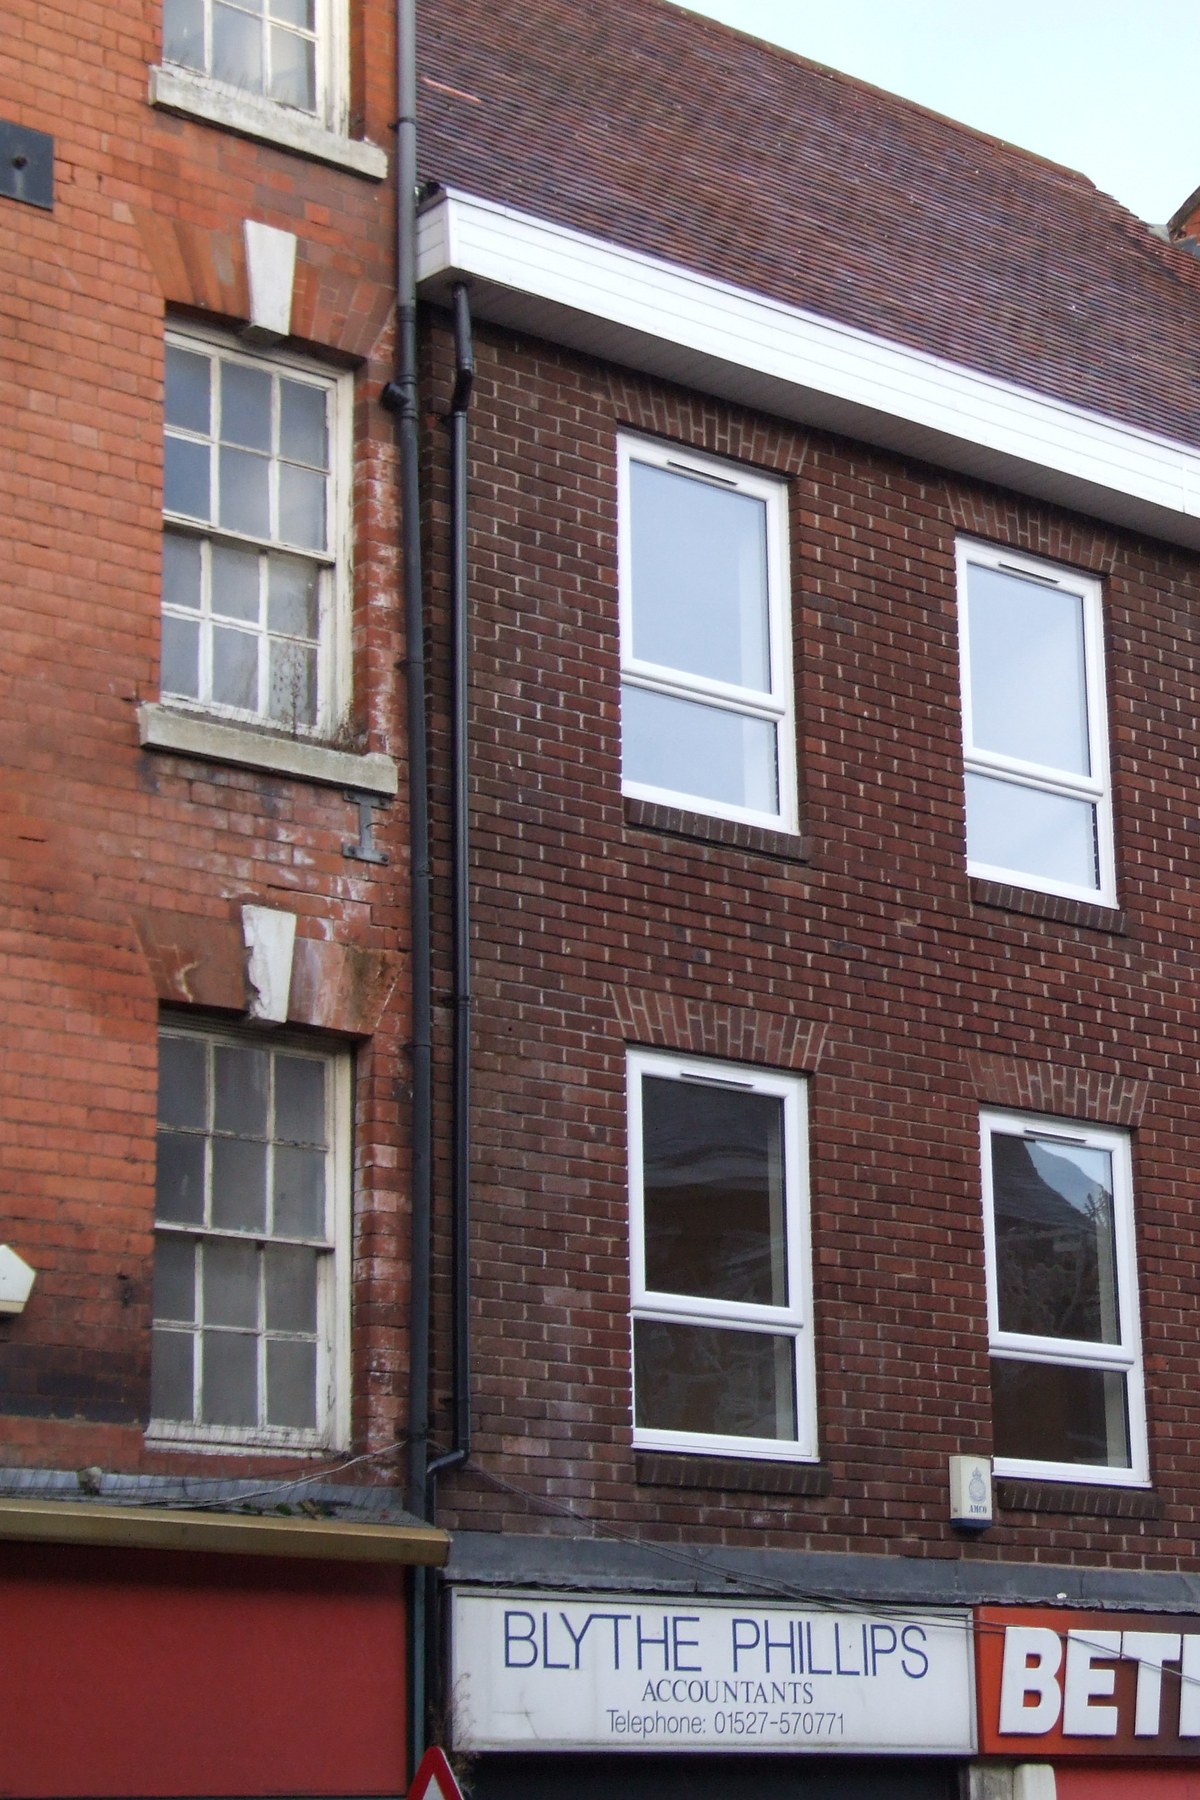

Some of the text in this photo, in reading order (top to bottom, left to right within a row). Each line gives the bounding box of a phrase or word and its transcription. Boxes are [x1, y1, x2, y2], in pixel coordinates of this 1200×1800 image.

[503, 1610, 929, 1679] BLYTHE PHILLIPS
[641, 1679, 814, 1705] ACCOUNTANTS
[606, 1709, 845, 1739] Telephone: 01527-570771
